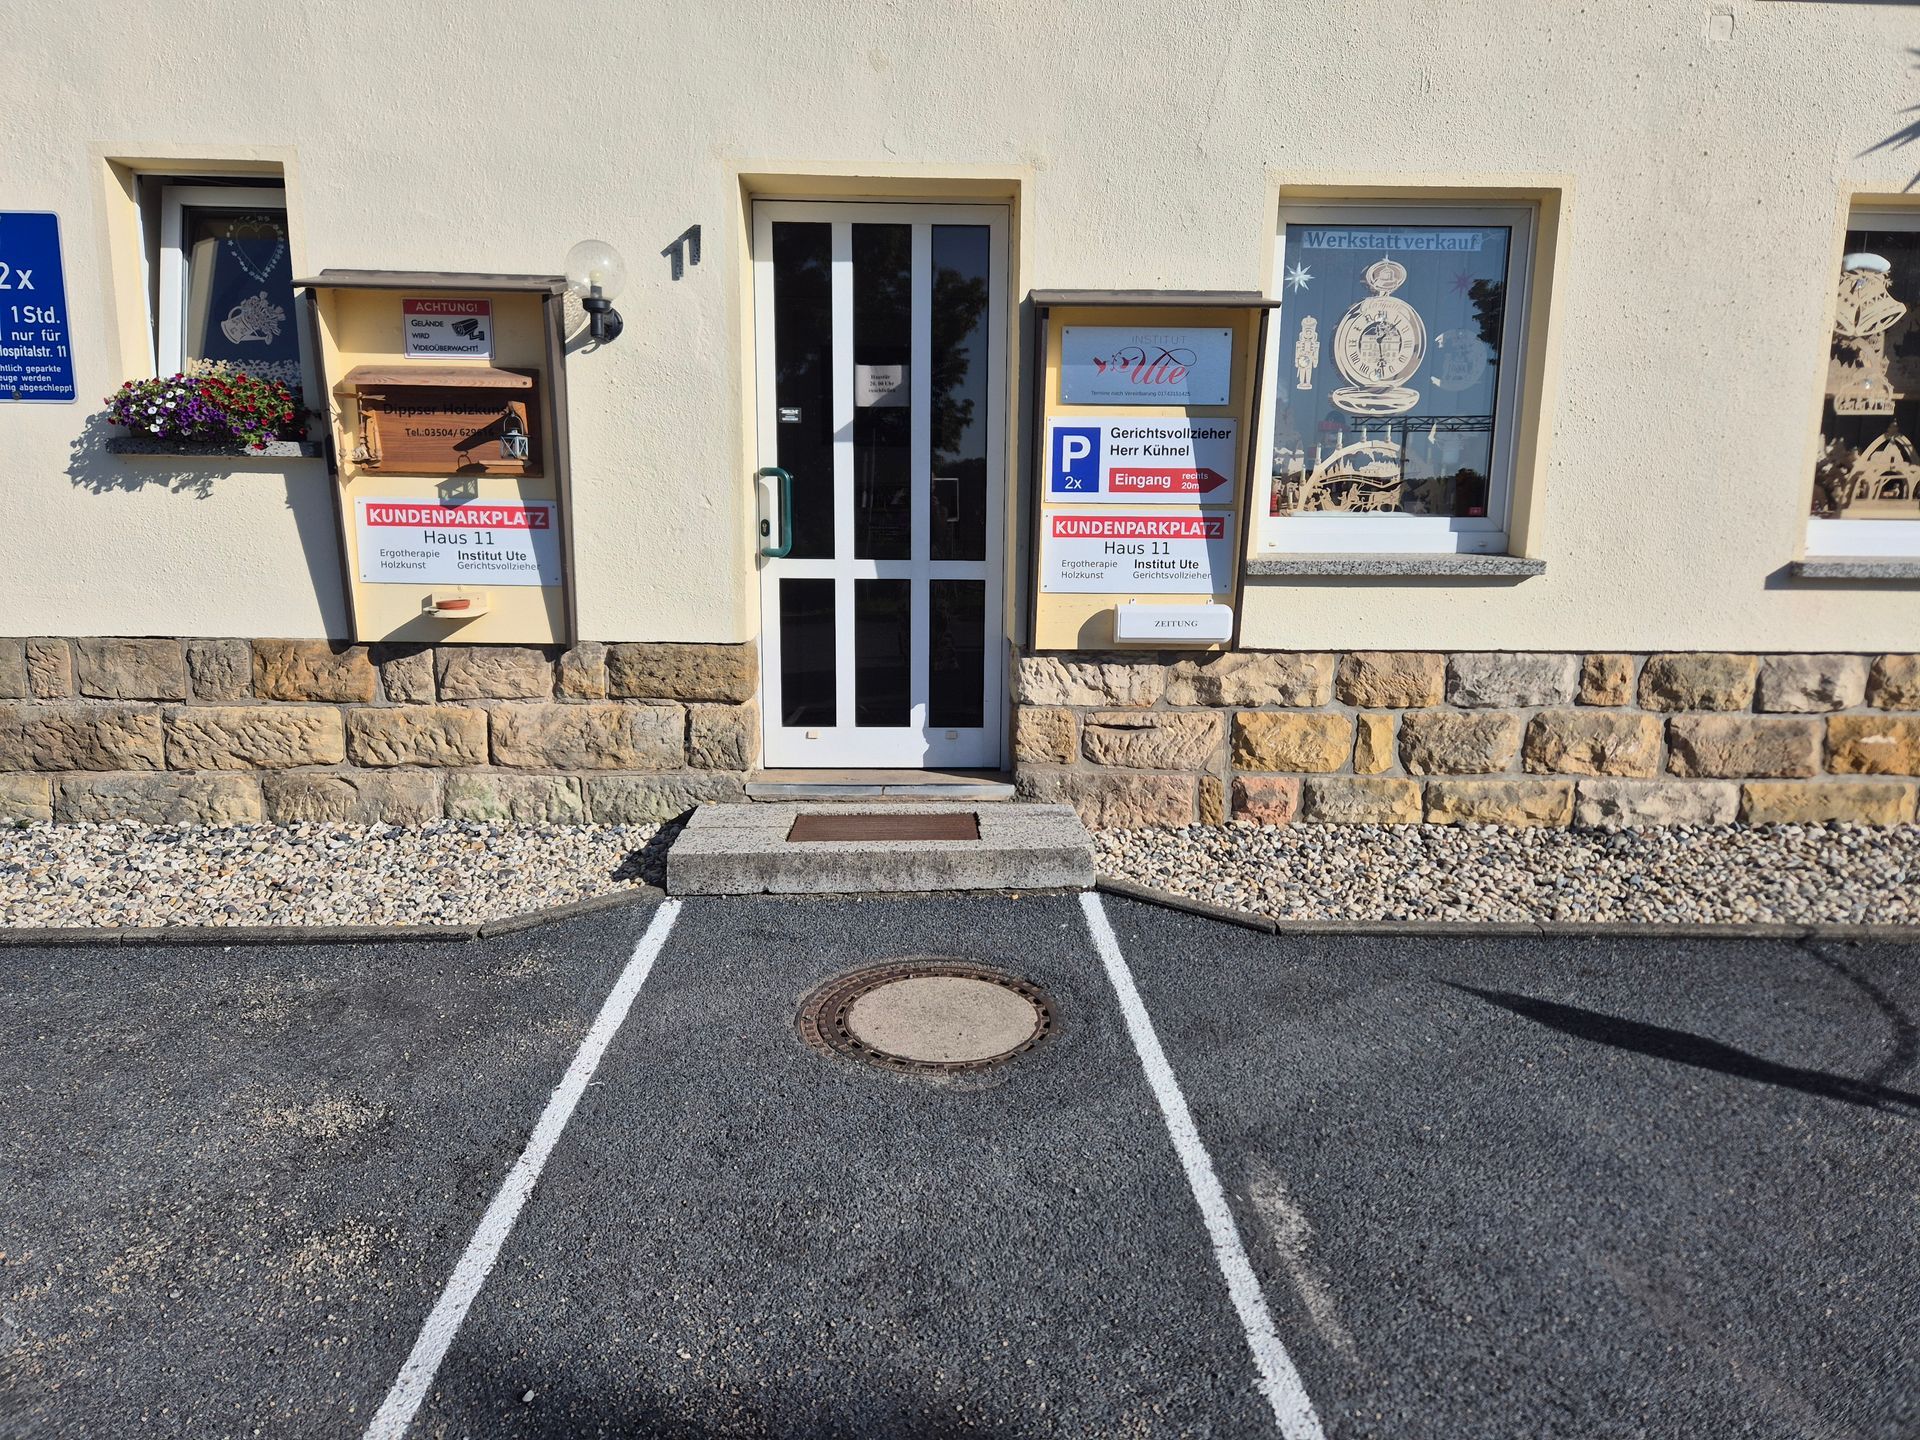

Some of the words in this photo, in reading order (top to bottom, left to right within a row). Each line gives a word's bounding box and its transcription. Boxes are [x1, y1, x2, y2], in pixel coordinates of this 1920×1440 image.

[660, 224, 702, 281] 11
[416, 301, 478, 313] ACHTUNG!
[23, 305, 61, 323] Std.
[11, 331, 35, 341] nur
[41, 329, 61, 341] für
[1132, 335, 1187, 345] INSTITUT
[57, 345, 67, 358] 11
[0, 364, 23, 372] htlich
[25, 364, 62, 373] geparkte
[1122, 346, 1198, 385] Ute
[21, 374, 52, 382] werden
[19, 384, 73, 393] abgeschleppt
[383, 403, 438, 417] Dippser
[443, 403, 509, 416] Holzkuns
[1110, 427, 1232, 440] Gerichtsvollzieher
[1062, 435, 1091, 473] P
[1110, 444, 1140, 456] Herr
[1143, 444, 1190, 456] Kühnel
[1064, 476, 1082, 489] 2x
[1115, 473, 1171, 488] Eingang
[1182, 472, 1209, 480] rechts
[1181, 482, 1200, 490] 20m
[369, 508, 546, 526] KUNDENPARKPLATZ
[1055, 520, 1221, 536] KUNDENPARKPLATZ
[423, 530, 468, 545] Haus
[475, 531, 495, 545] 11
[380, 548, 441, 559] Ergotherapie
[457, 549, 503, 561] Institut
[506, 550, 528, 561] Ute
[1104, 541, 1145, 555] Haus
[1151, 541, 1171, 555] 11
[380, 560, 427, 569] Holzkunst
[457, 561, 541, 571] Gerichtsvollzieher
[1061, 560, 1118, 569] Ergotherapie
[1134, 559, 1176, 570] Institut
[1179, 559, 1199, 570] Ute
[1061, 571, 1104, 580] Holzkunst
[1132, 571, 1213, 580] Gerichtsvollzieher
[1154, 620, 1198, 628] ZEITUNG
